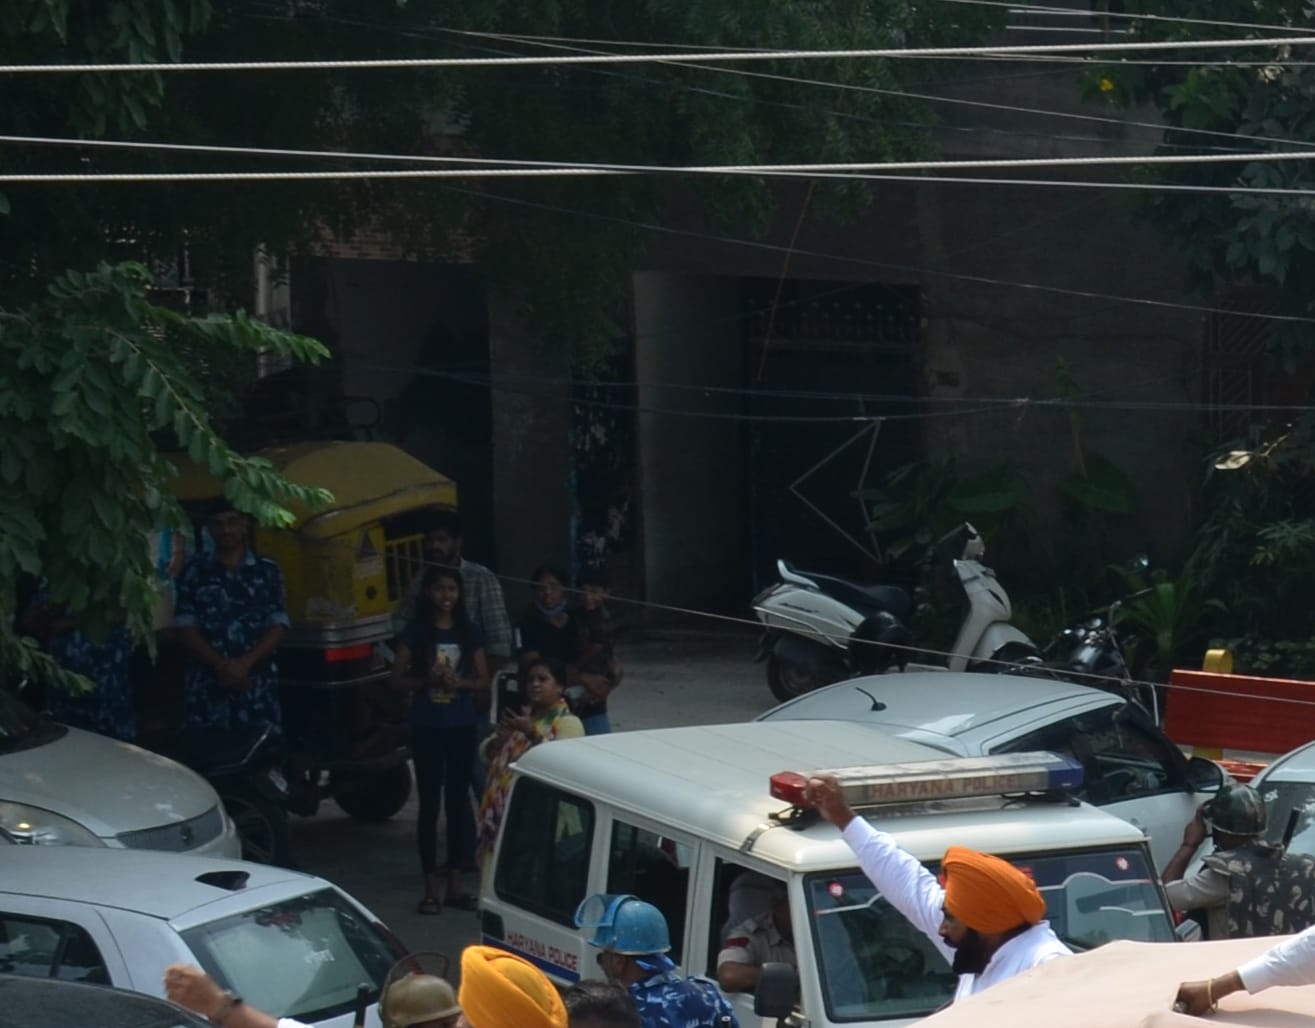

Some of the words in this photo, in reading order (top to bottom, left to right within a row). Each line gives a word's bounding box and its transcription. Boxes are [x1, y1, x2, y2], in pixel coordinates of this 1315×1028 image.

[871, 778, 954, 798] HARYANA
[962, 773, 1017, 792] POLICE
[507, 932, 545, 957] HARYANA
[549, 945, 577, 971] POLICE
